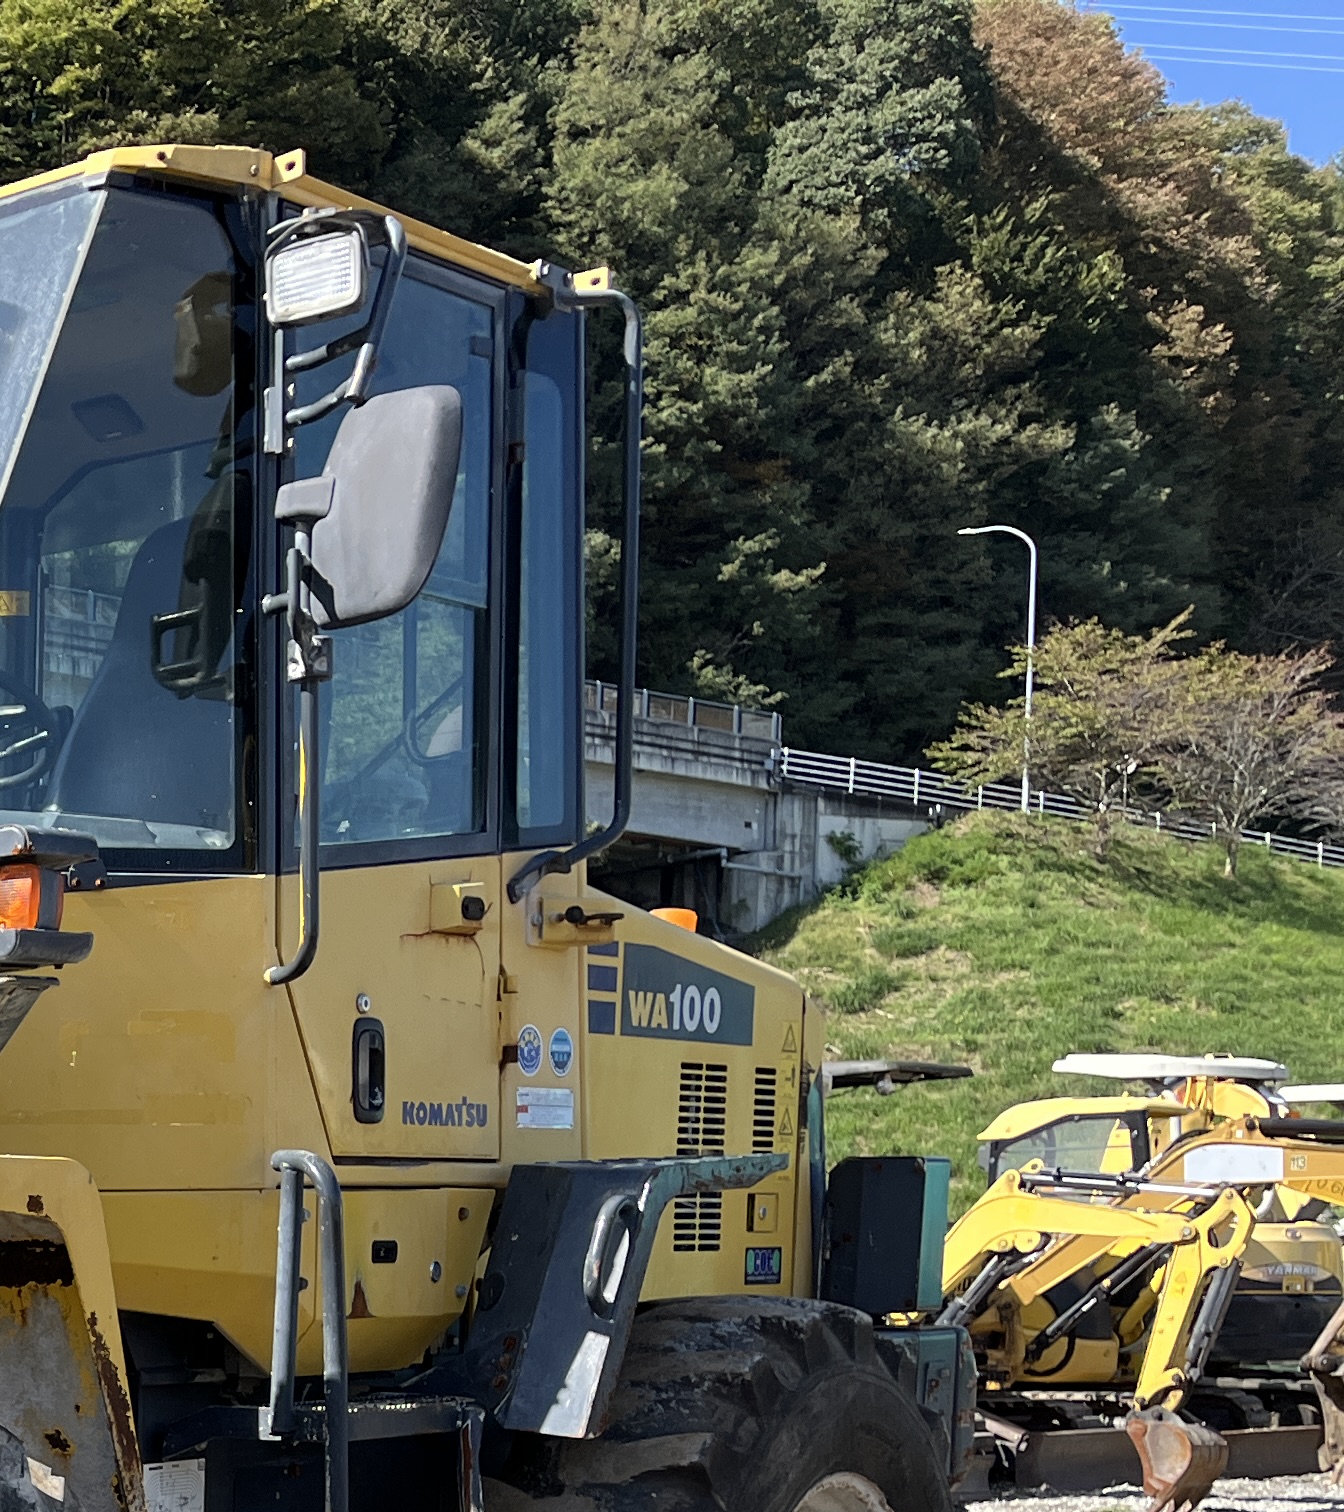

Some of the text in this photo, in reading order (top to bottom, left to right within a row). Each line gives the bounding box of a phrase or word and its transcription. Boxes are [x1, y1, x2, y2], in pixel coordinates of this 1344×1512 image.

[629, 984, 721, 1034] WA100
[402, 1096, 487, 1128] KOMATSU
[1266, 1264, 1318, 1276] YANMAR
